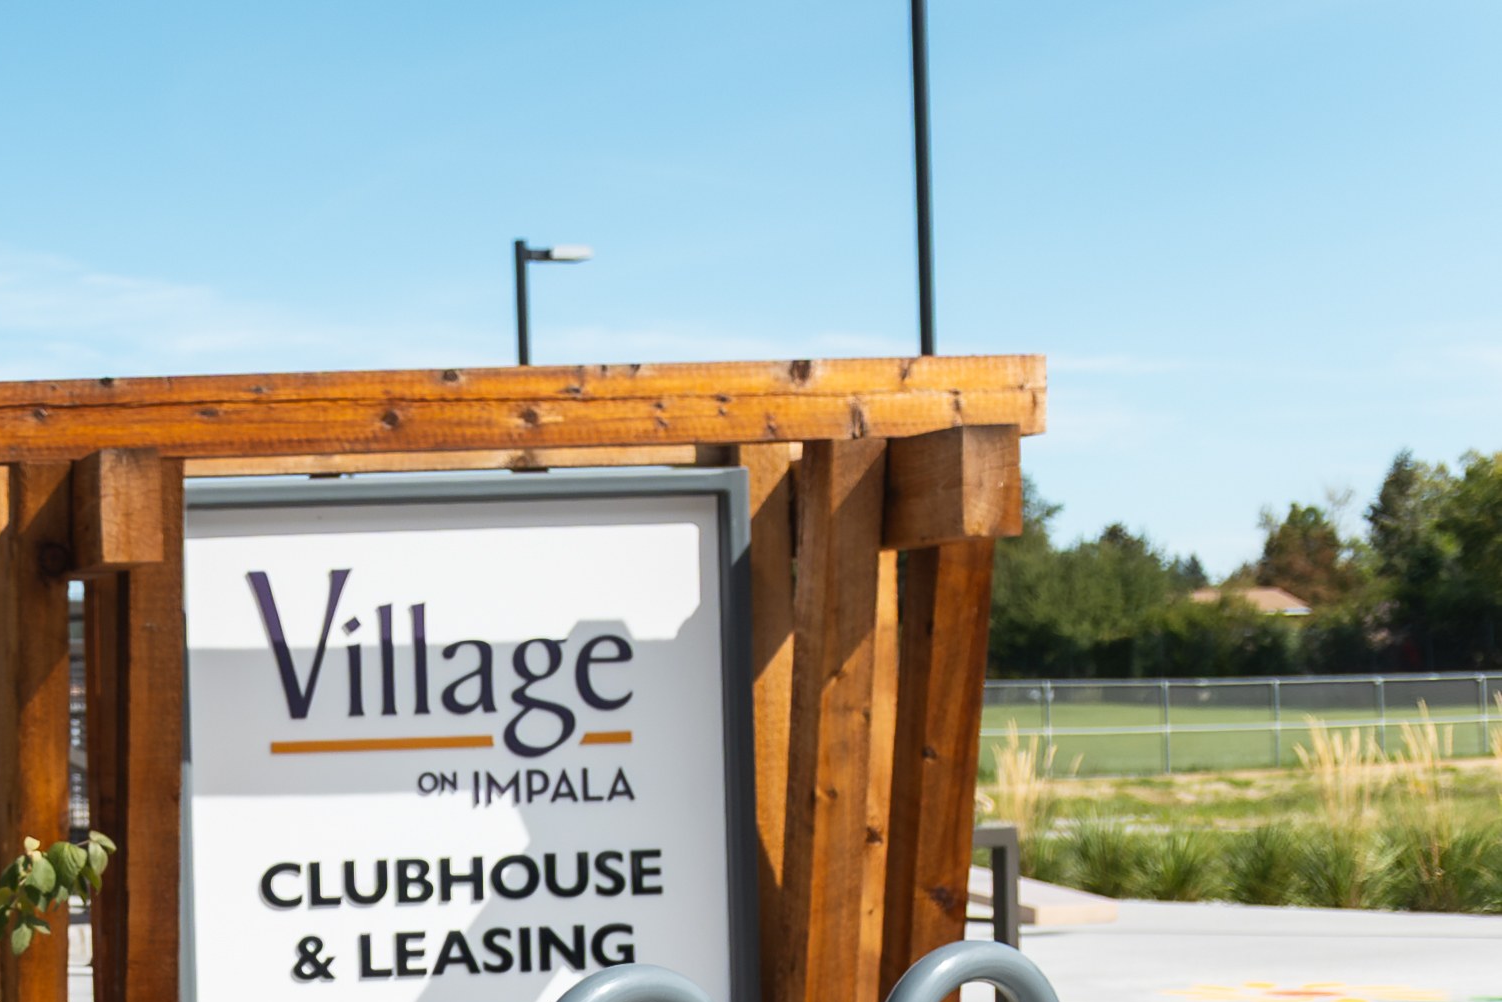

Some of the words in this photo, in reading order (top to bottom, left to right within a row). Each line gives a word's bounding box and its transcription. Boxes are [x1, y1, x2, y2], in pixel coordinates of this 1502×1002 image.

[247, 568, 634, 758] Village
[417, 771, 458, 796] ON
[473, 767, 635, 808] IMPALA
[260, 849, 663, 907] CLUBHOUSE
[292, 935, 336, 981] &
[359, 923, 636, 978] LEASING
